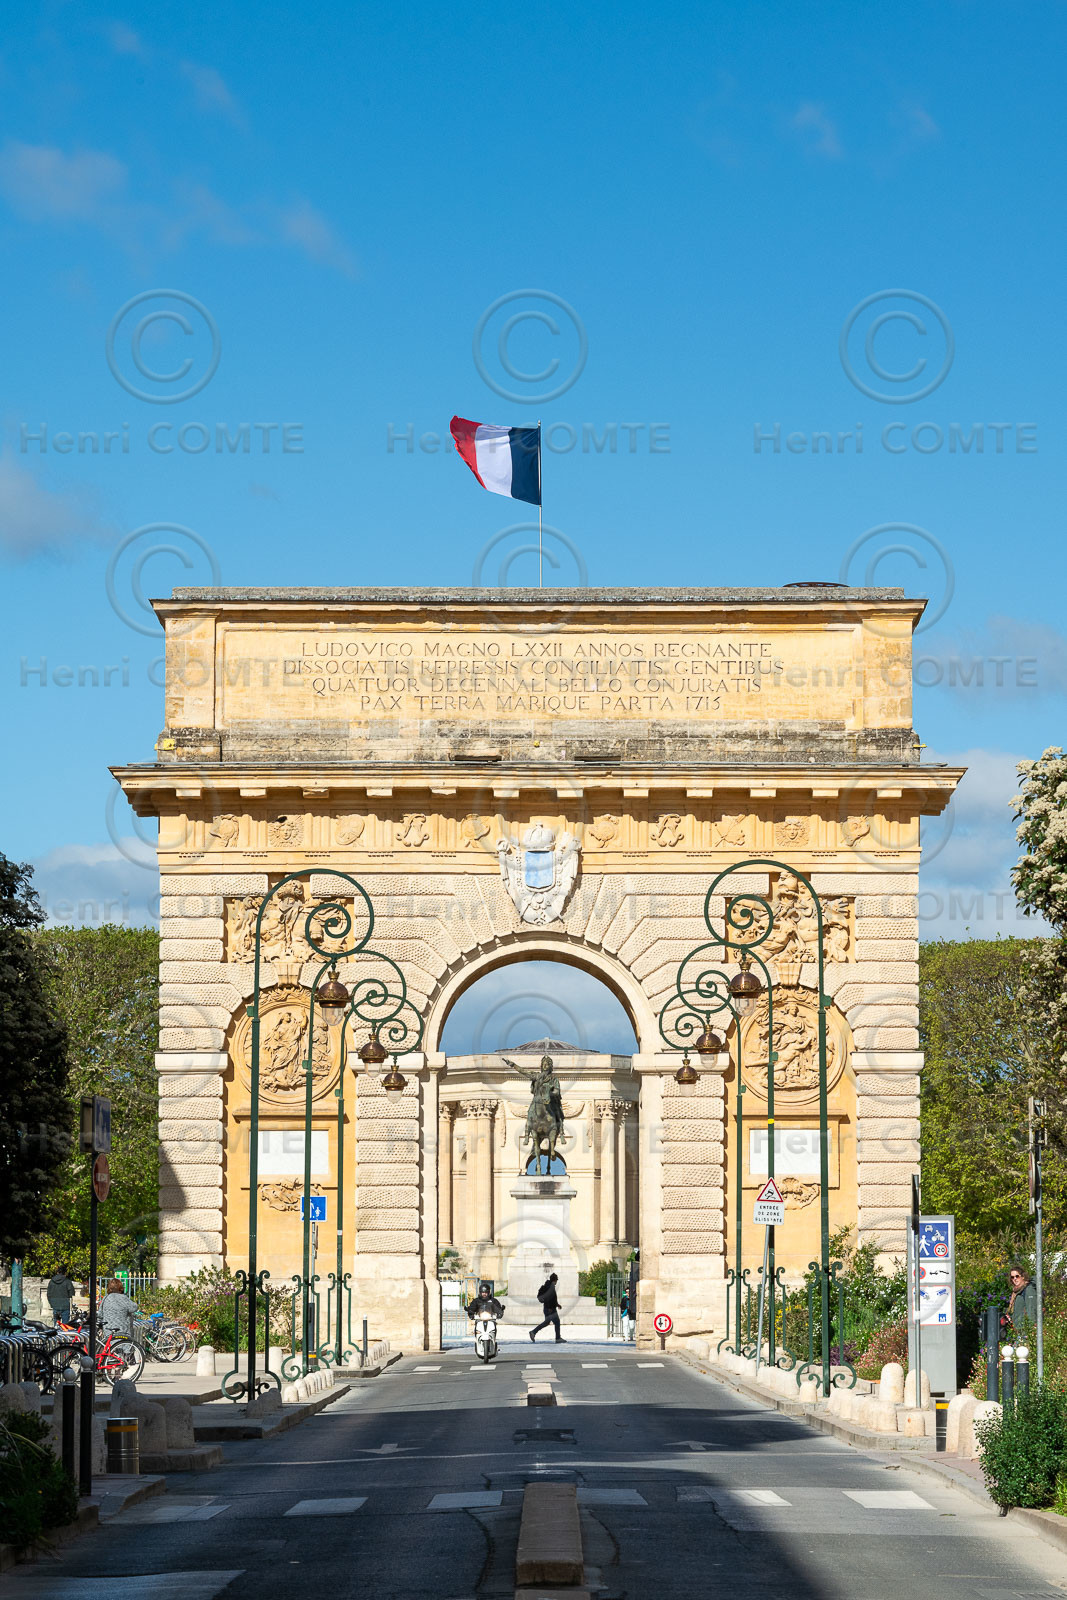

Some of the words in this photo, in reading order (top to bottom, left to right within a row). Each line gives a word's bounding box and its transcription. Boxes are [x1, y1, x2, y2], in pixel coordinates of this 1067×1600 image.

[302, 642, 413, 657] LUDOVICO
[424, 642, 501, 657] MAGNO
[511, 642, 563, 657] LXXII
[573, 643, 644, 657] ANNOS
[654, 643, 772, 657] REGNANTE
[283, 660, 410, 675] DISSOCIATIS
[421, 660, 519, 675] REPRESSIS
[531, 660, 663, 675] CONCILIATIS
[674, 660, 784, 675] GENTIBUS
[312, 677, 420, 697] QUATUOR
[431, 678, 548, 693] DECENNALI
[559, 678, 622, 693] BELLO
[633, 678, 762, 693] CONJURATIS
[361, 695, 402, 710] PAX
[414, 695, 486, 710] TERRA
[496, 695, 590, 714] MARIQUE
[601, 695, 674, 710] PARTA
[685, 696, 722, 711] 1715
